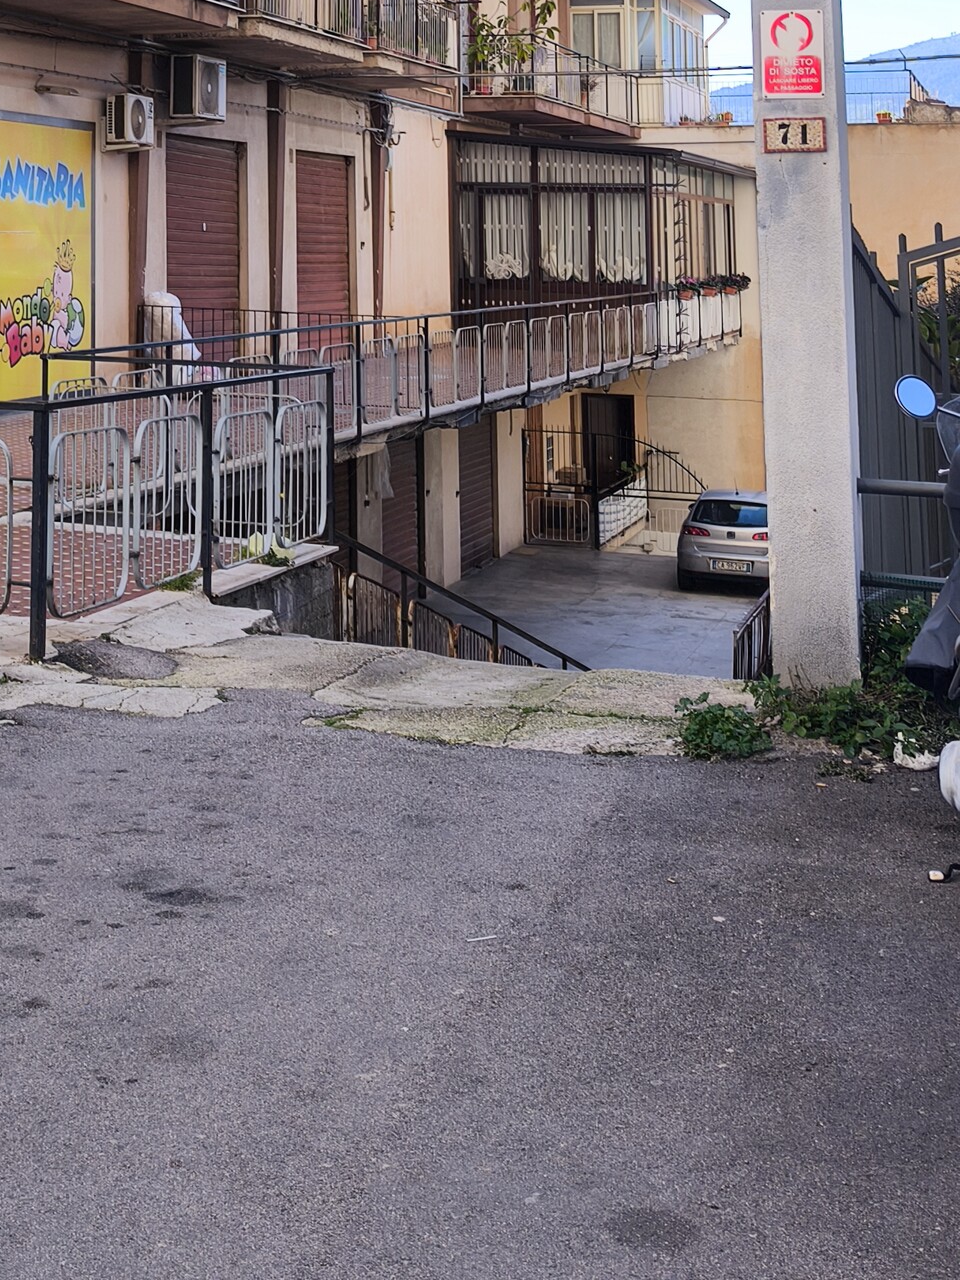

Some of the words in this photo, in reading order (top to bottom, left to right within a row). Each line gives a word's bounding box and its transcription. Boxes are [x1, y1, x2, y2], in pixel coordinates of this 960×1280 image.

[769, 68, 779, 76] DI
[784, 67, 817, 76] SOSTA
[778, 122, 809, 145] 71
[6, 315, 54, 368] Baby
